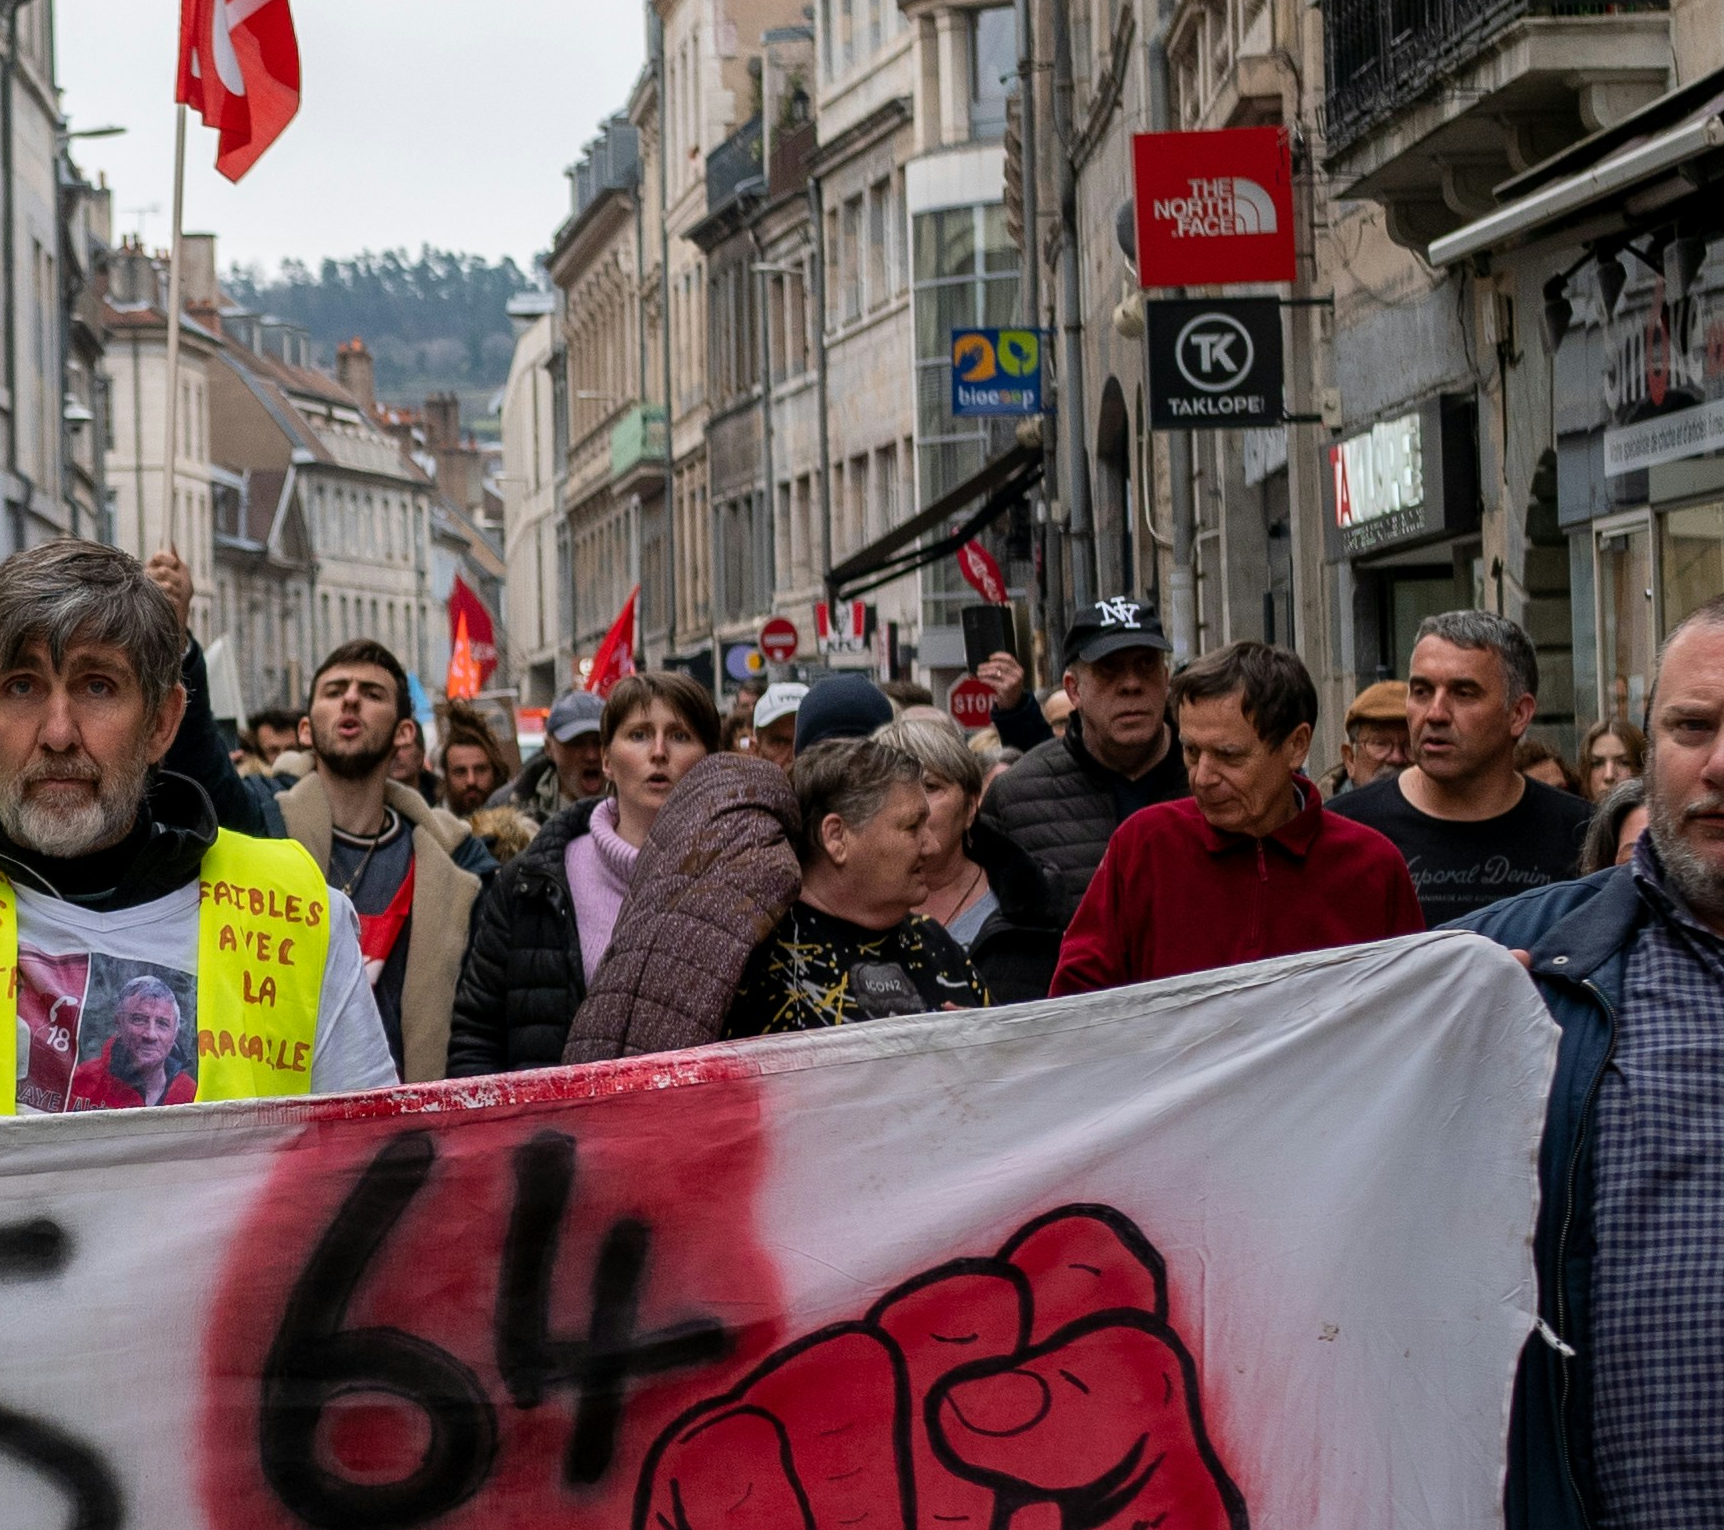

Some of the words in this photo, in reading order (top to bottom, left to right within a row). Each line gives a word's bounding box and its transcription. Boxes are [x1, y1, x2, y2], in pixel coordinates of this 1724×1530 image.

[1187, 177, 1232, 199] THE
[1153, 197, 1234, 220] NORTH
[1177, 217, 1234, 238] FACE
[1095, 596, 1141, 628] NY
[200, 881, 323, 927] FAIBLES
[220, 924, 295, 966] AVEC
[243, 970, 276, 1007] LA
[47, 1025, 70, 1052] 18
